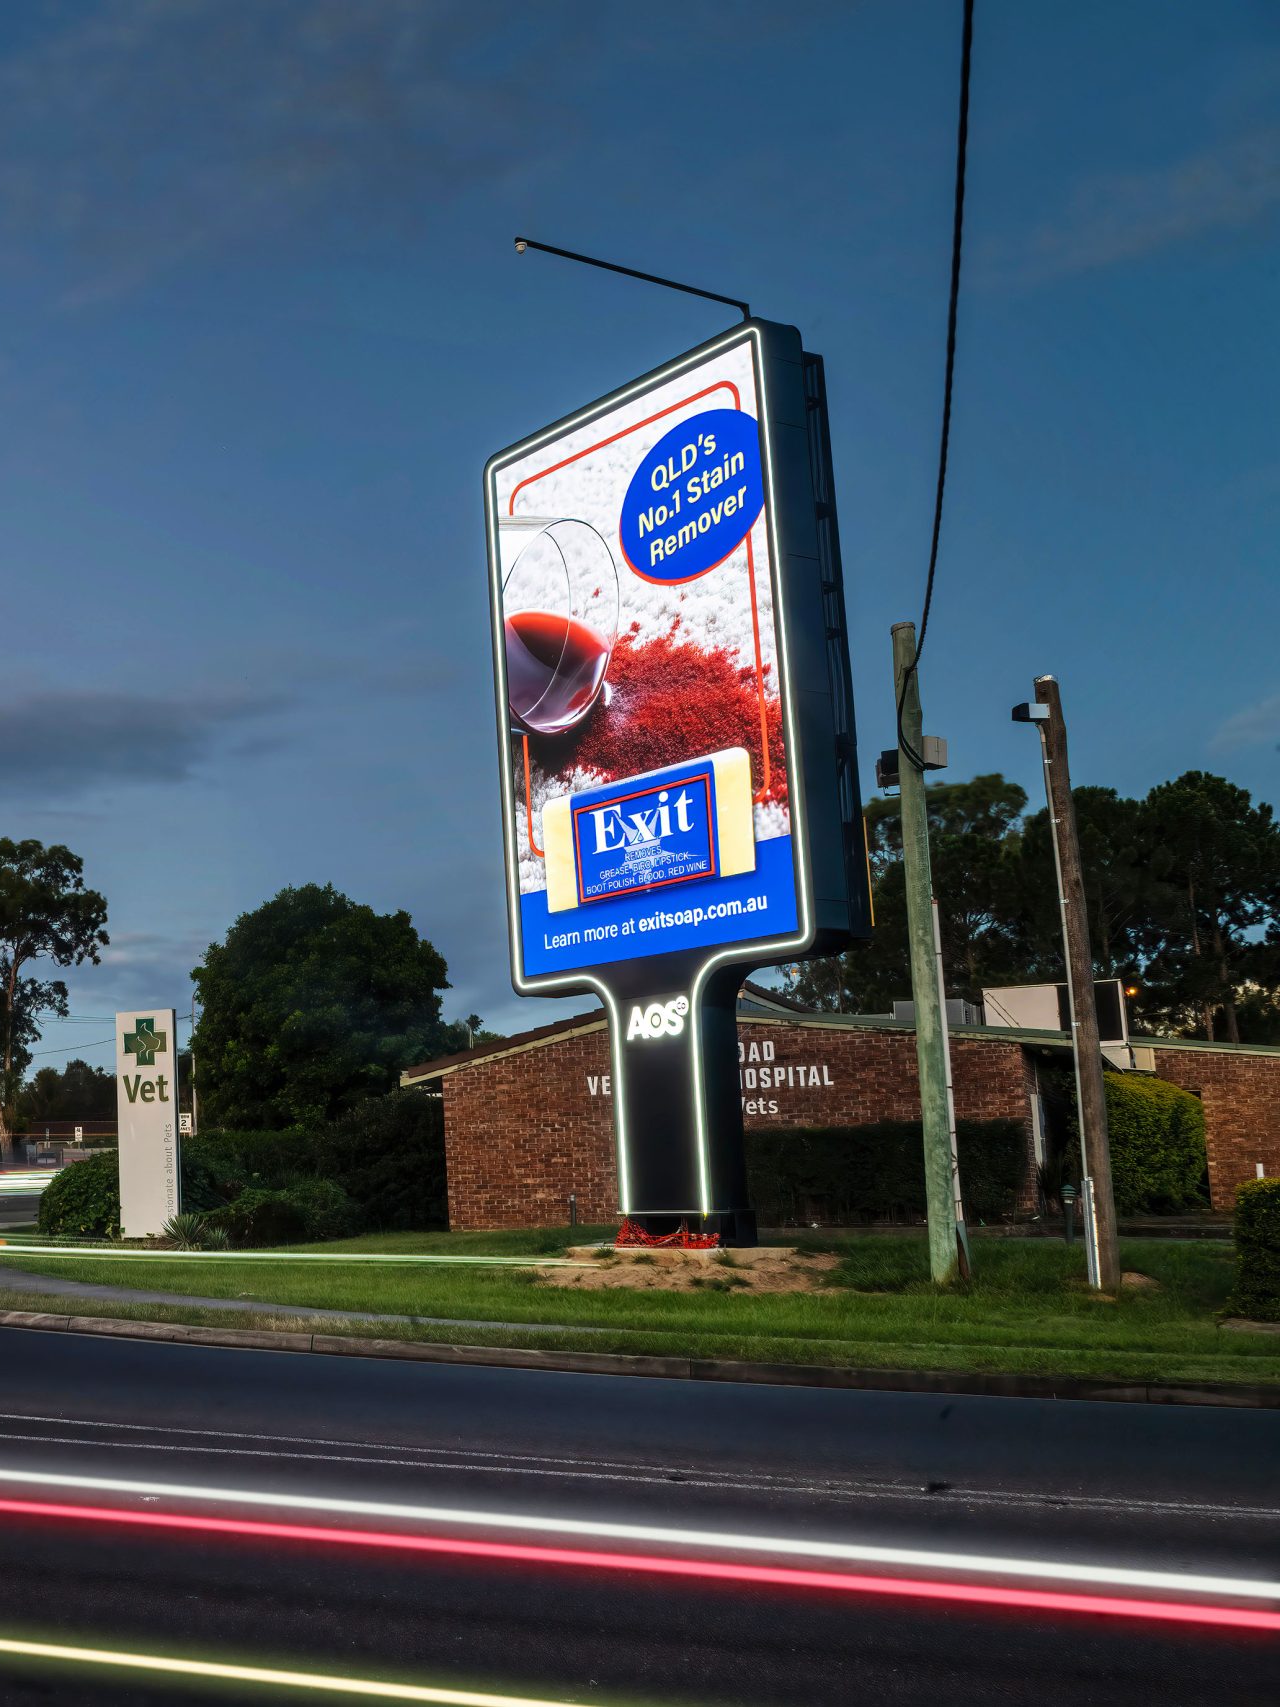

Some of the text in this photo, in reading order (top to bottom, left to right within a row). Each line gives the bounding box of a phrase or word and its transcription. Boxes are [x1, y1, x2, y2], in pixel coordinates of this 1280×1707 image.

[651, 434, 717, 492] QLD's
[638, 451, 745, 539] No.1 Stain
[649, 485, 747, 567] Remover
[589, 789, 695, 855] Exit
[624, 845, 662, 861] REMOVES
[586, 882, 607, 895] BOOT
[668, 865, 685, 877] RED
[686, 859, 708, 873] WINE
[544, 895, 768, 950] Learn more at exitsoap.com.au
[626, 999, 686, 1041] AOS
[738, 1041, 775, 1062] OAD
[122, 1074, 170, 1103] Vet
[739, 1065, 835, 1089] OSPITAL
[164, 1123, 172, 1143] Pets
[180, 1119, 187, 1127] 2
[164, 1146, 173, 1174] about
